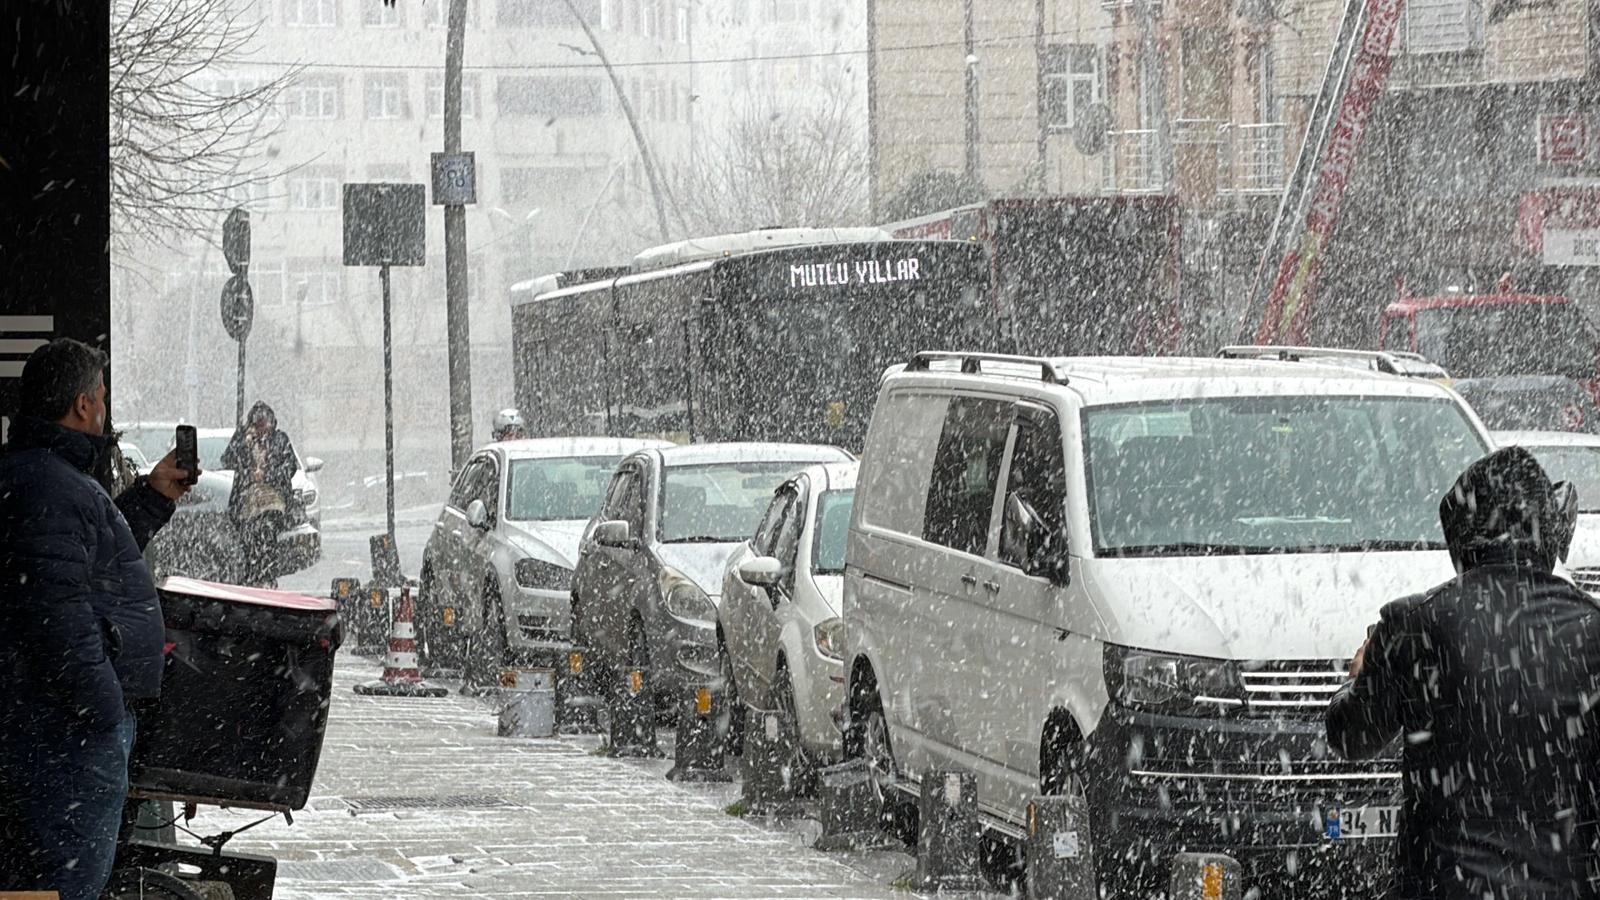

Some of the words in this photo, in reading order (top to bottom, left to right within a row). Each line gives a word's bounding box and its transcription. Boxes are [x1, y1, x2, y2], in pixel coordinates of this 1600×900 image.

[790, 263, 849, 288] MUTLU
[855, 258, 920, 284] YILLAR
[1341, 810, 1367, 834] 34
